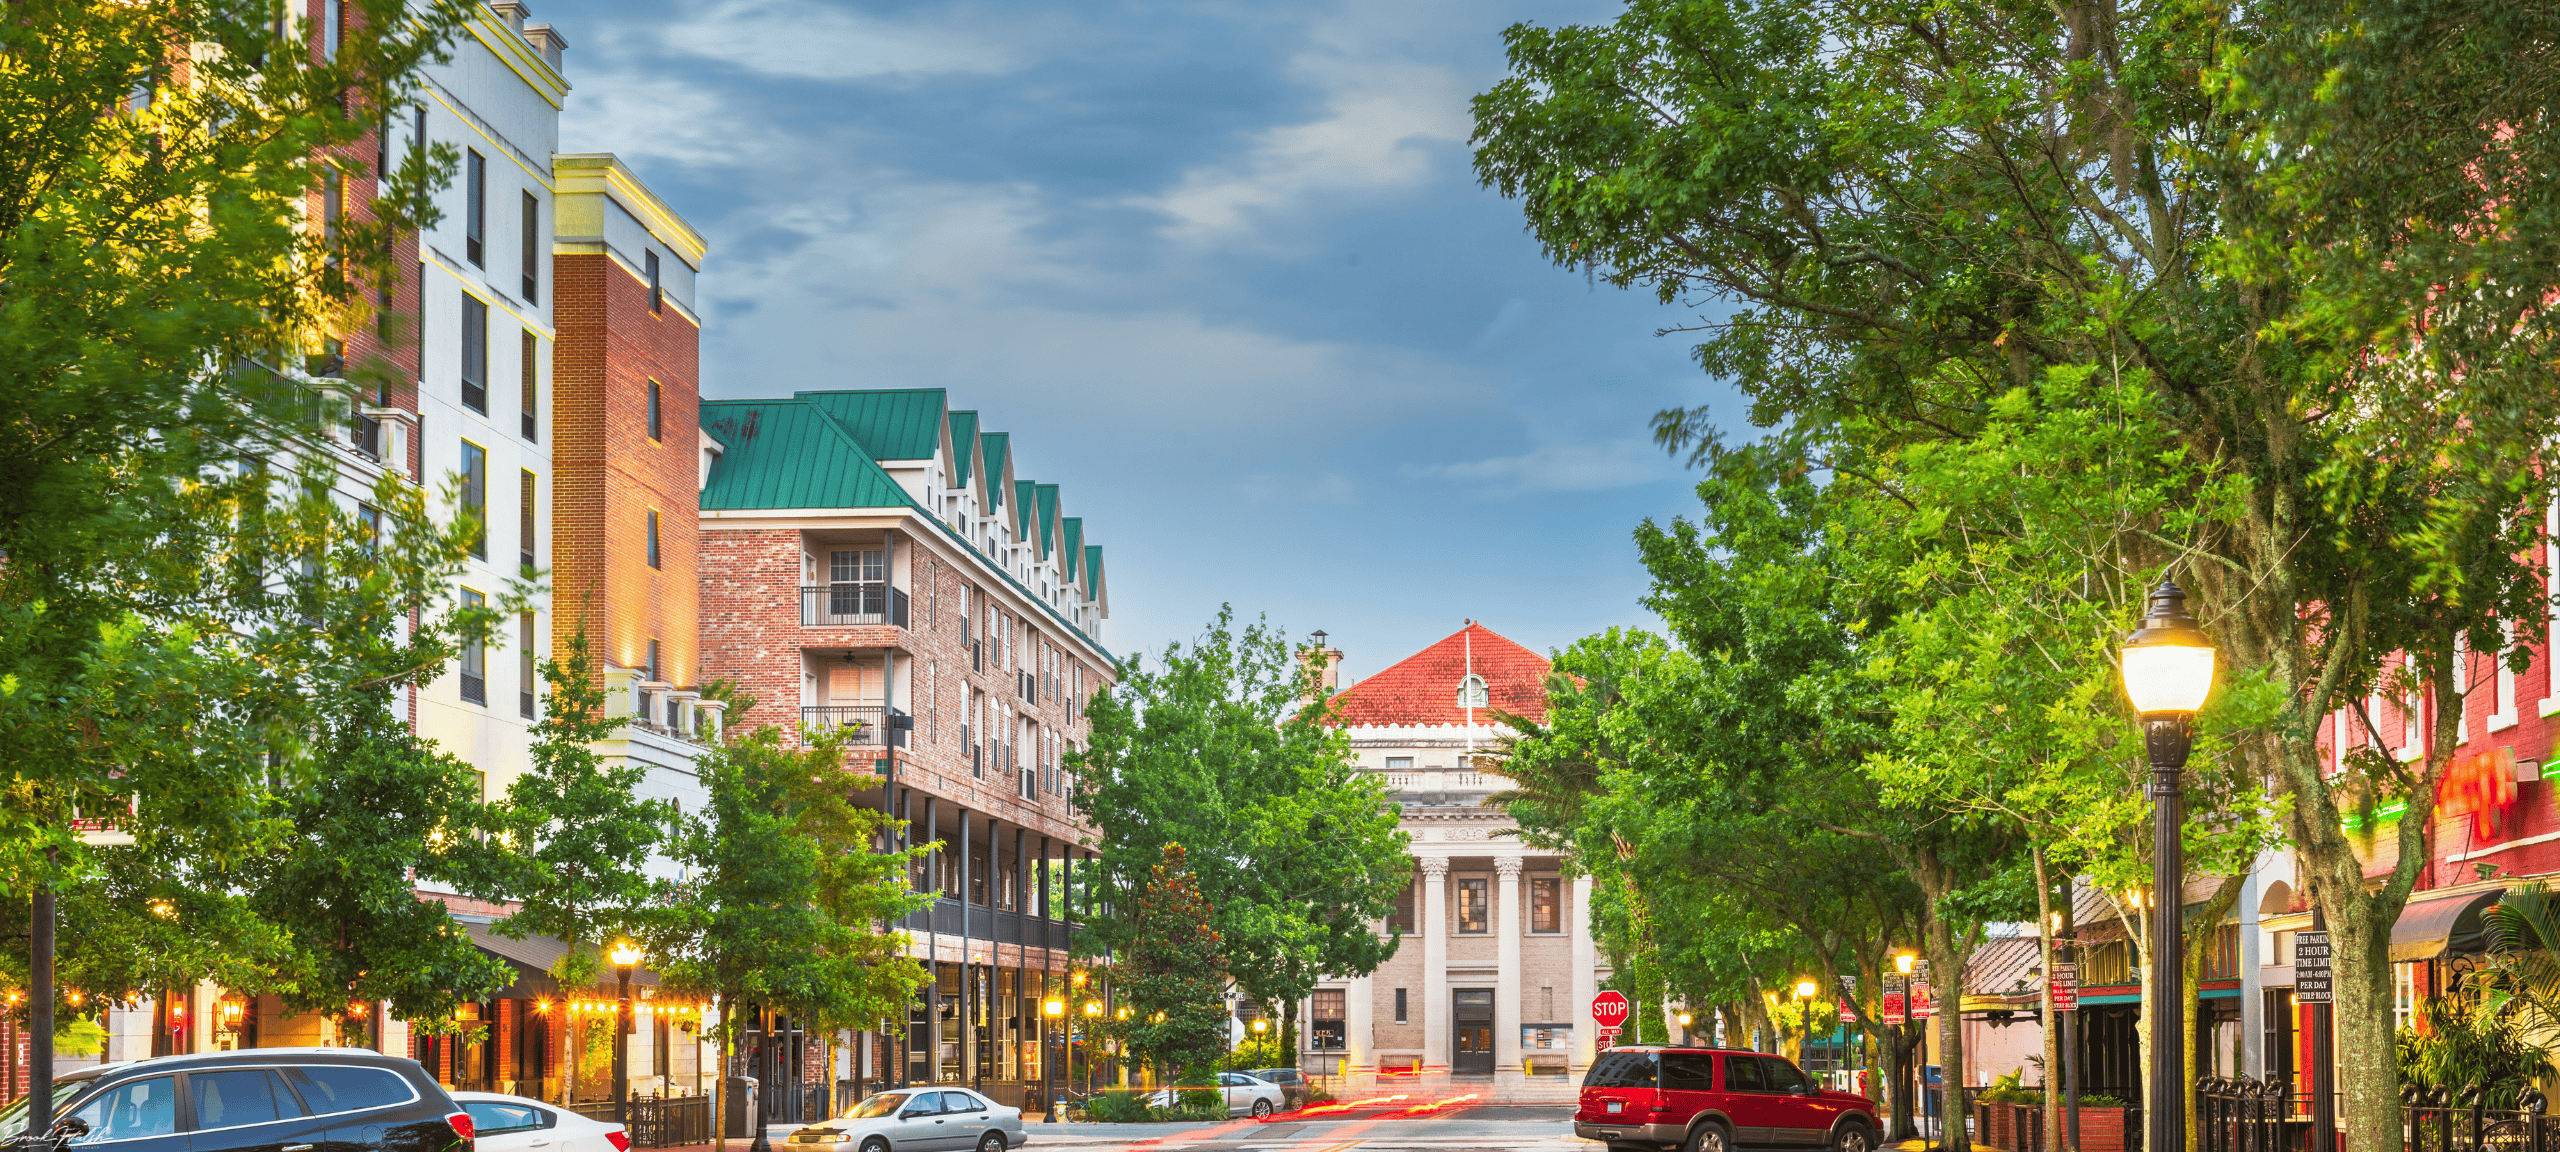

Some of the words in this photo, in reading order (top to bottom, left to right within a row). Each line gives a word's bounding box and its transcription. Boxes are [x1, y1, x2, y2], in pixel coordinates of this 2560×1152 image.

[2296, 935, 2309, 944] FREE
[2310, 935, 2329, 944] PARKIN
[2298, 947, 2304, 956] 2
[2305, 946, 2329, 956] HOUR
[2296, 958, 2313, 967] TIME
[2314, 957, 2331, 967] LIMIT
[2300, 981, 2313, 989] PER
[2314, 981, 2327, 989] DAY
[1594, 1001, 1626, 1016] STOP
